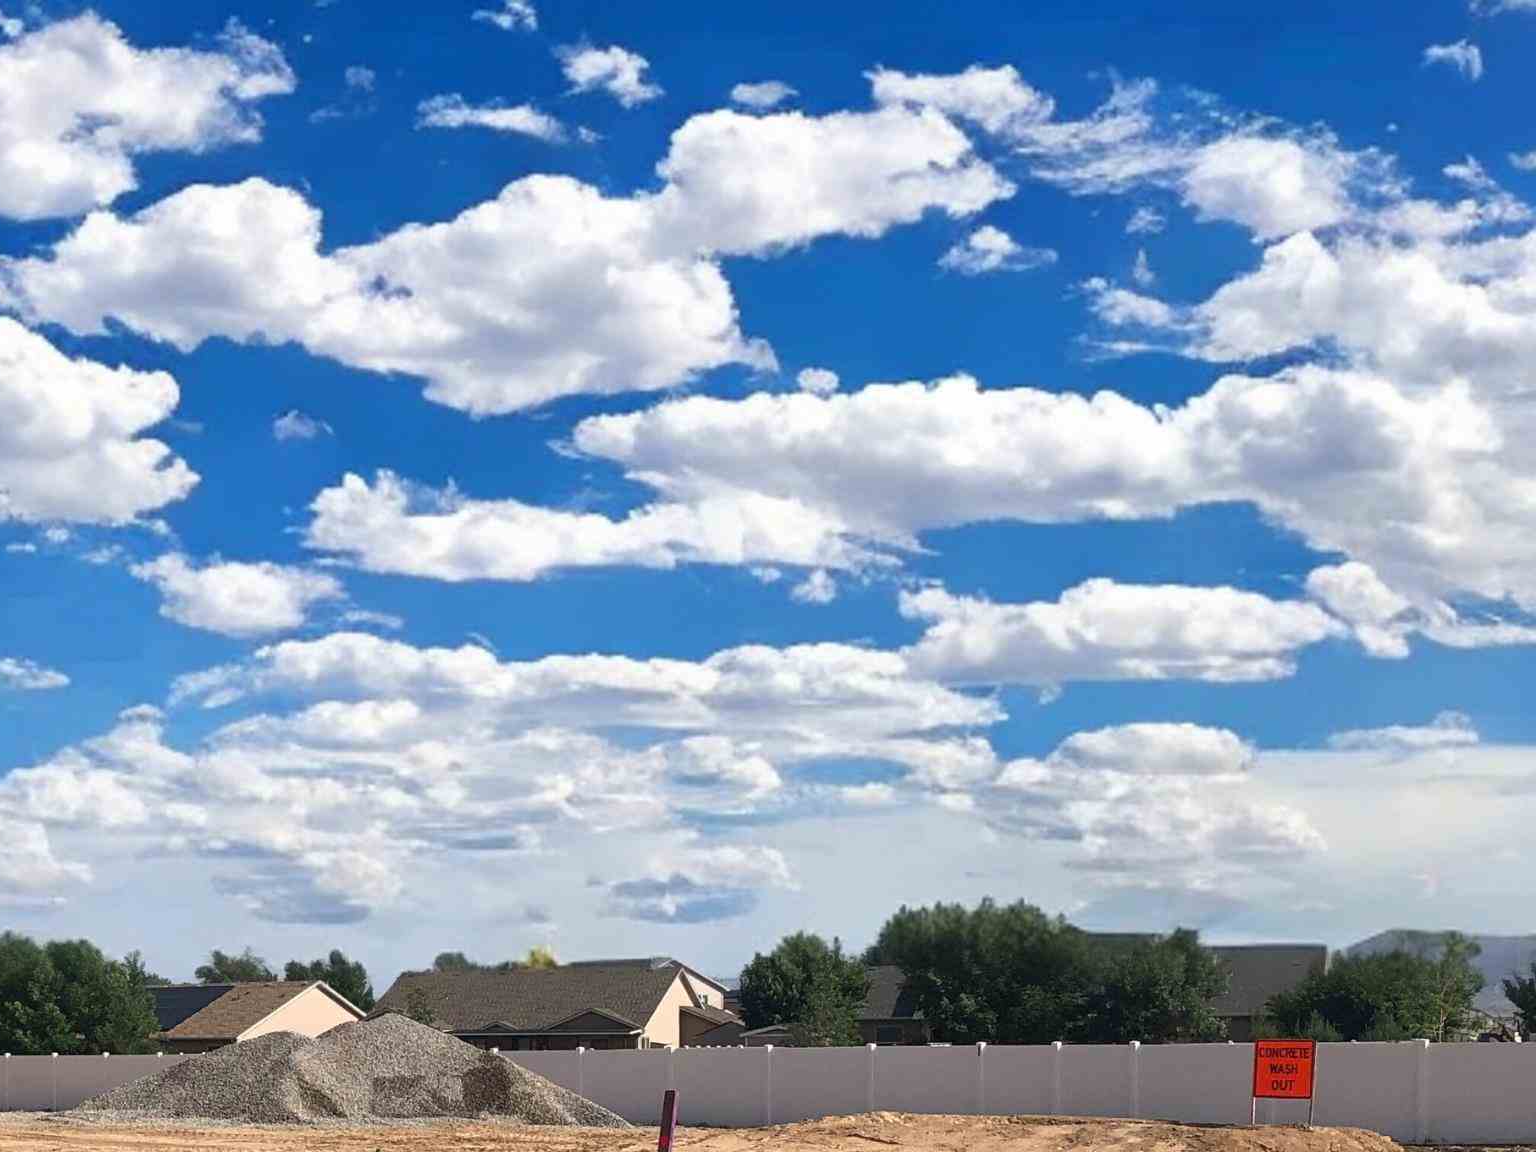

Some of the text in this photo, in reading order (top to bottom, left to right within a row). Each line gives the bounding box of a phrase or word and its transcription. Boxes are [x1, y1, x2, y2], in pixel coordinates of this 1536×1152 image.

[1259, 1047, 1310, 1059] CONCRETE
[1270, 1063, 1298, 1074] WASH
[1271, 1079, 1296, 1091] OUT
